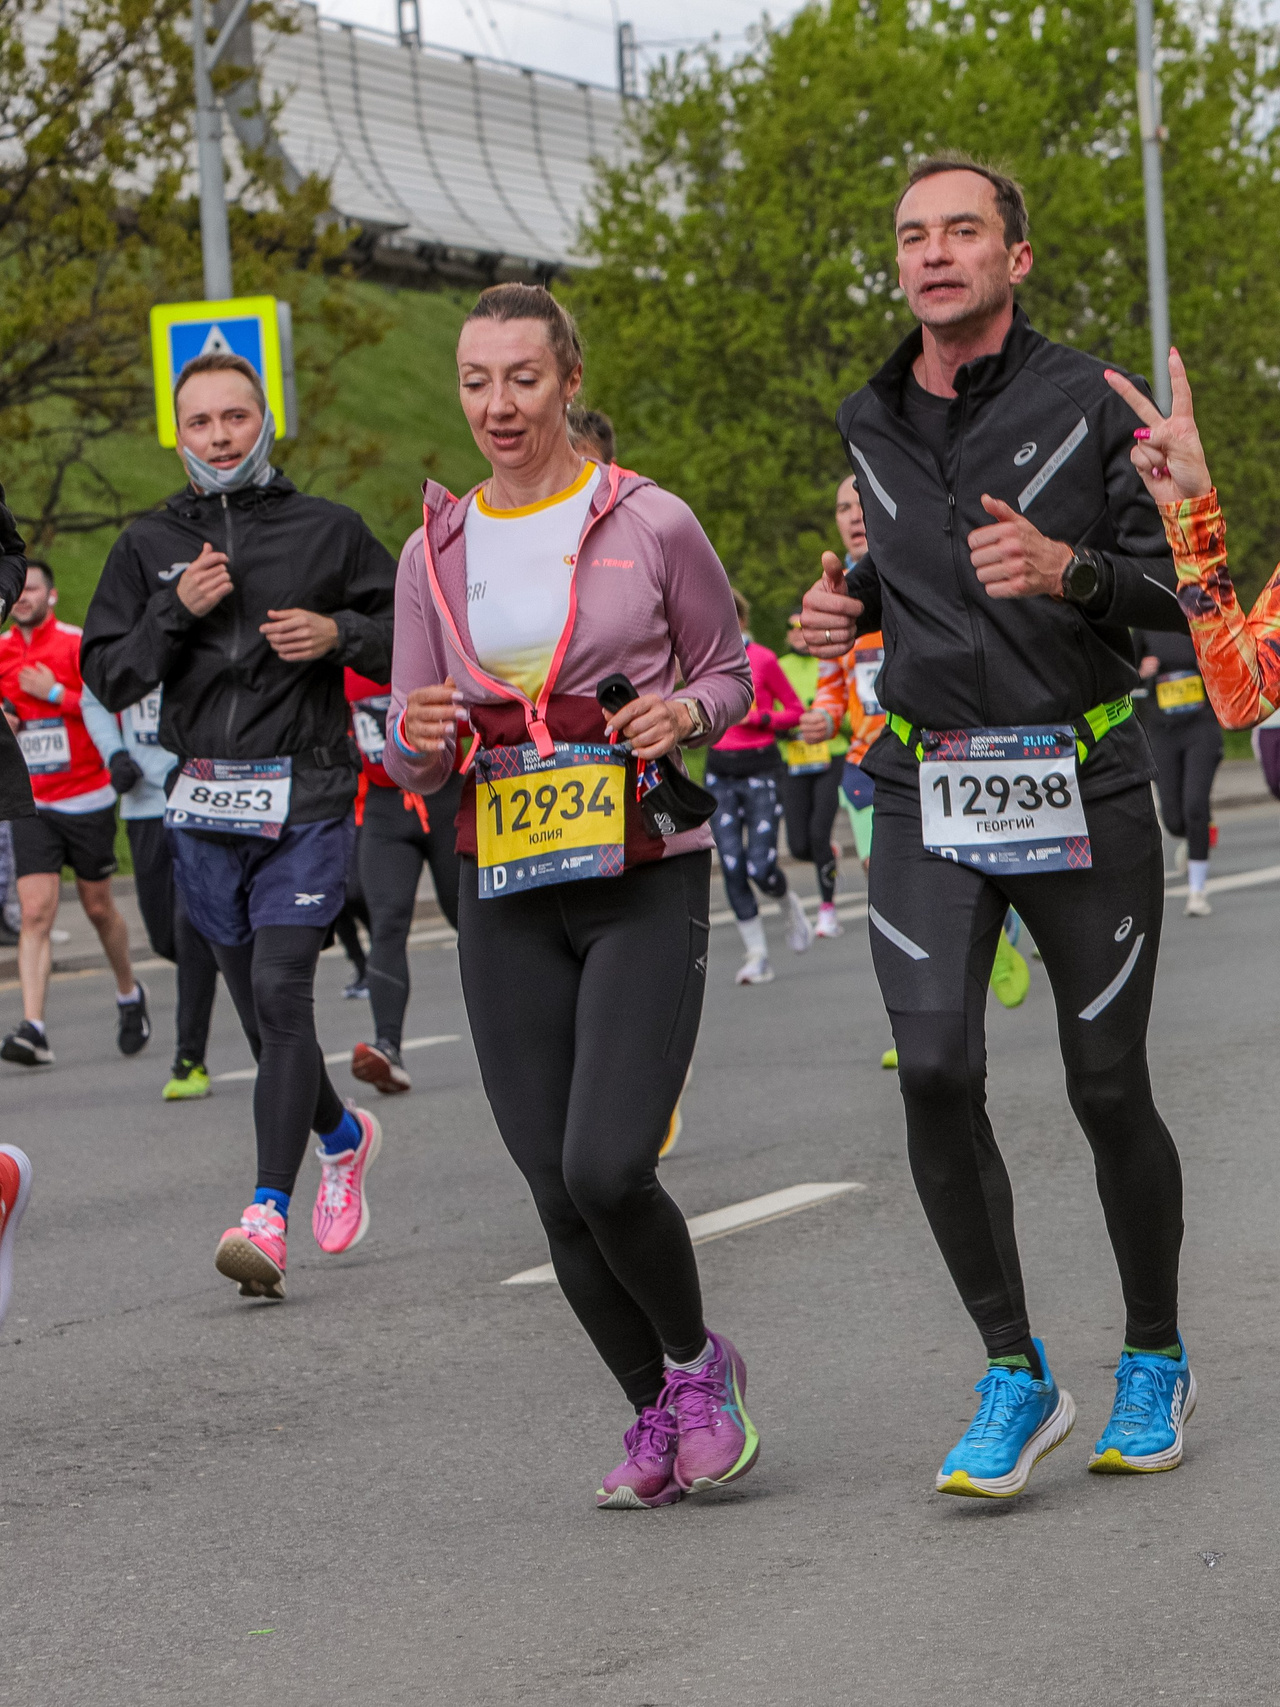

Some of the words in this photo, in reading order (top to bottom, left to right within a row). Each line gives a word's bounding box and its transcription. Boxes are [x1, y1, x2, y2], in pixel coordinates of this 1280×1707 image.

[602, 558, 634, 568] TERREX
[971, 734, 1018, 745] МОСКОВСКИЙ
[970, 749, 1005, 757] МАРАФОН
[524, 759, 556, 772] МАРАФОН
[190, 787, 273, 812] 8853
[933, 772, 1072, 818] 12938
[488, 777, 615, 836] 12934
[173, 810, 188, 823] D
[976, 816, 1035, 833] ГЕОРГИЙ
[529, 828, 563, 845] ЮЛИЯ
[492, 865, 507, 891] D
[1170, 1376, 1184, 1434] HOKA
